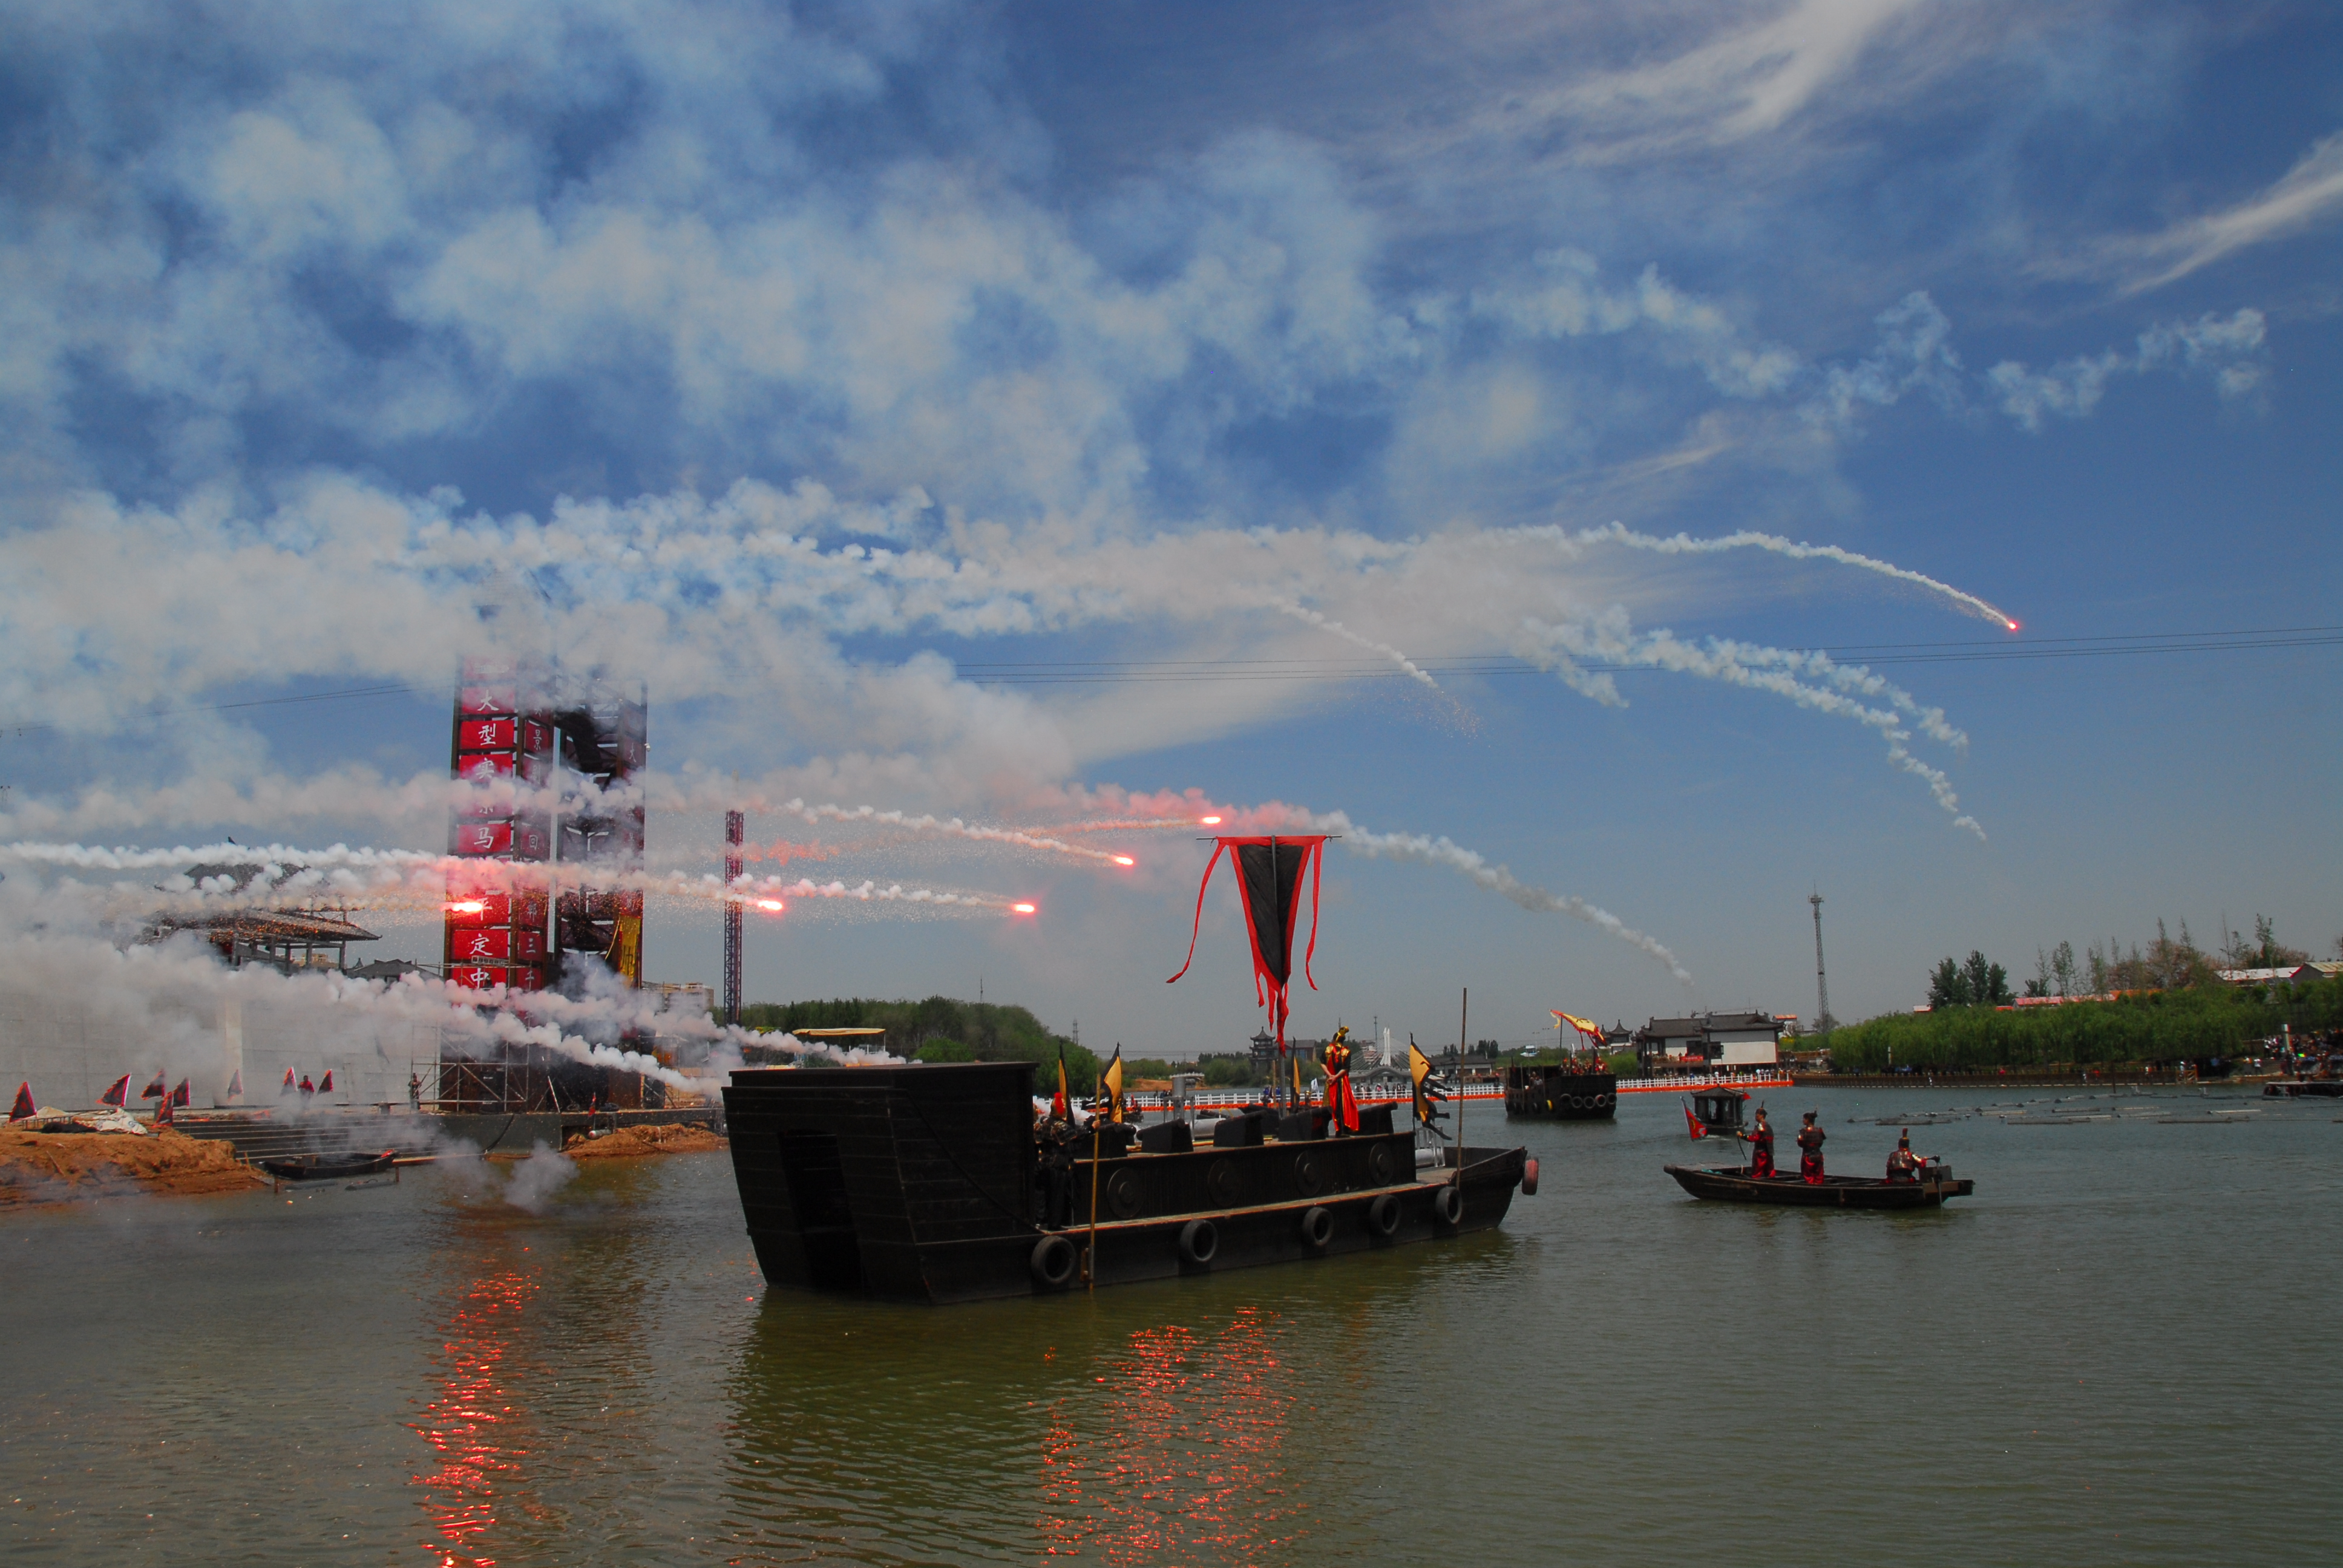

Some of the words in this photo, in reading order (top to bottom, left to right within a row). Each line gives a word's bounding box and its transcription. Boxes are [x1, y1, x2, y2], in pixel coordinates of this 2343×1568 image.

[470, 689, 500, 988] 大型实马平定中
